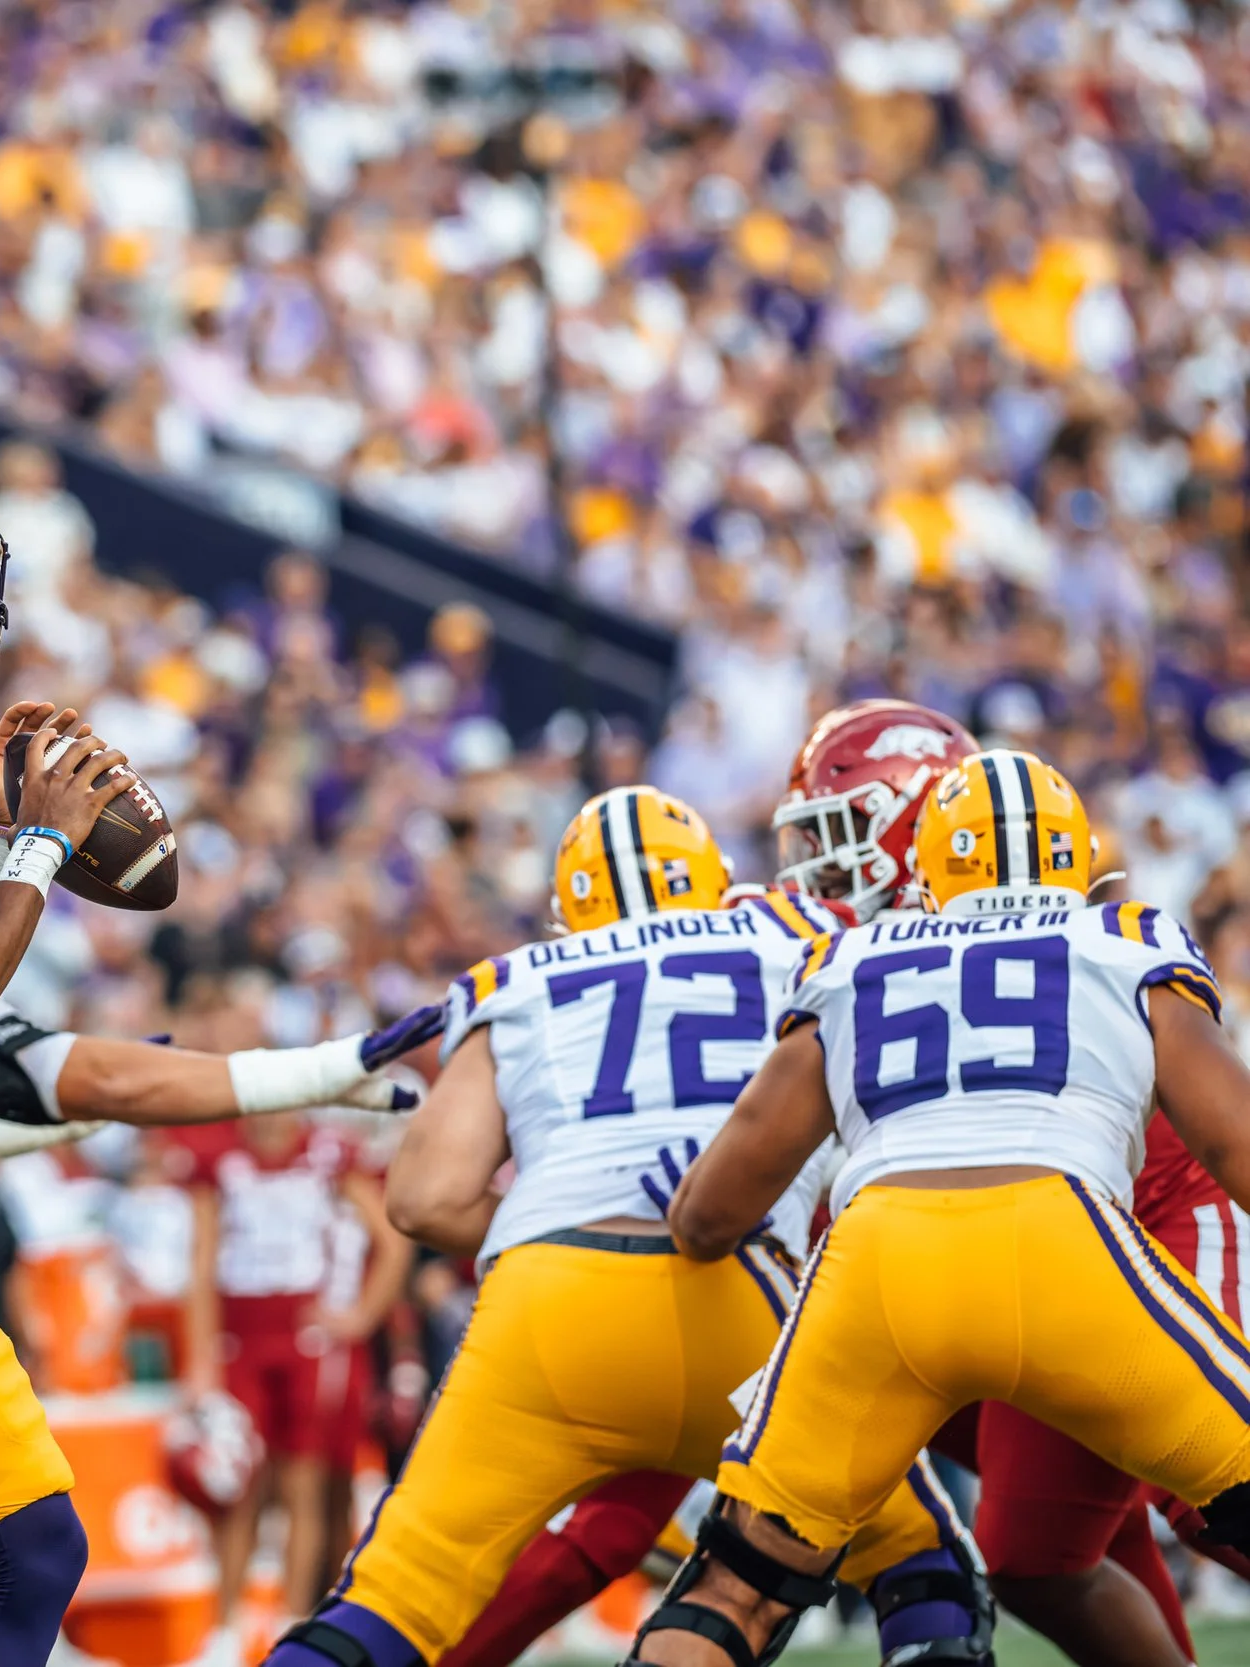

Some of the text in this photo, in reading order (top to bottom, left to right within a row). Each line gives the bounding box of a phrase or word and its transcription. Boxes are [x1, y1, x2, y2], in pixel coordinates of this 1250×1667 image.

[957, 832, 969, 852] 3
[975, 894, 1068, 911] TIGERS
[528, 909, 757, 968] DELLINGER
[870, 913, 1028, 945] TURNER
[547, 949, 767, 1120] 72
[853, 934, 1070, 1125] 69
